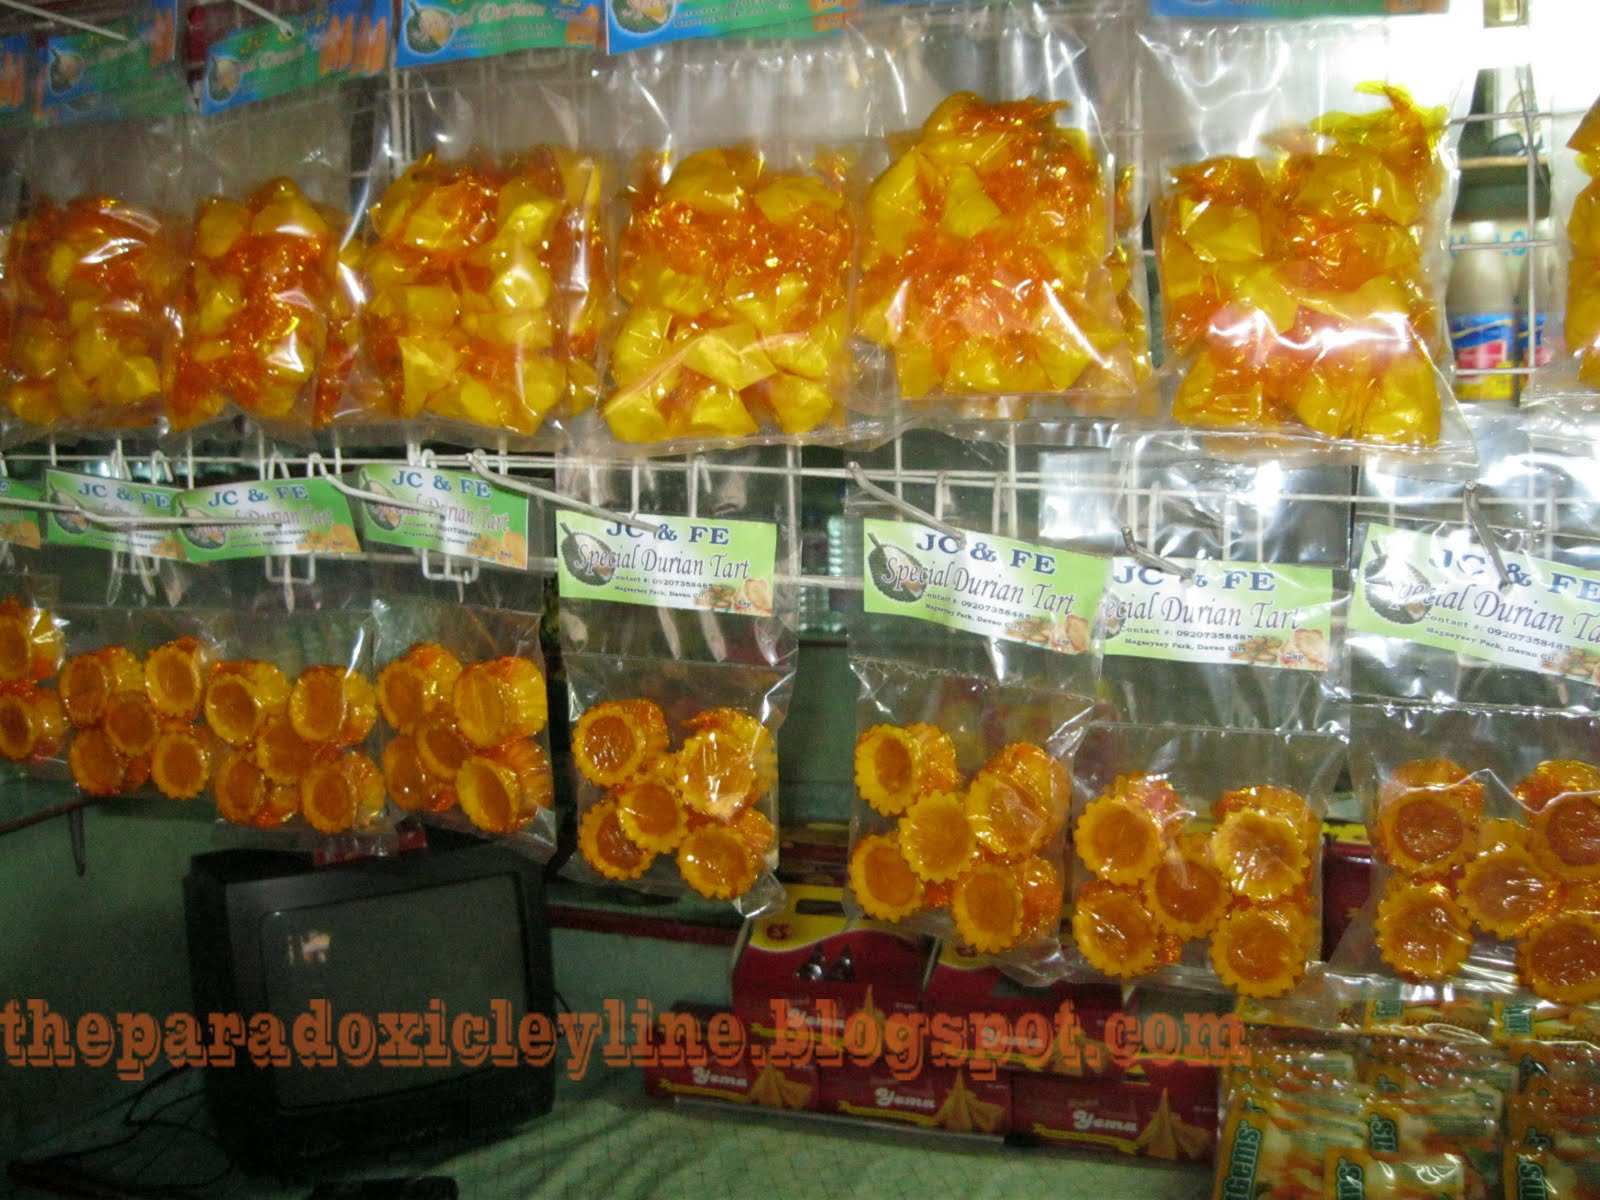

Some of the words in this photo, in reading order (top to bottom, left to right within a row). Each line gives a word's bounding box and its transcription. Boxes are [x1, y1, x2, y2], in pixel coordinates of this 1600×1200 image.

[78, 482, 107, 498] JC
[116, 487, 133, 502] &
[140, 490, 171, 508] FE
[208, 490, 239, 507] JC
[248, 488, 269, 503] &
[275, 484, 309, 500] FE
[392, 470, 423, 488] JC
[432, 475, 452, 491] &
[459, 477, 492, 499] FE
[656, 523, 678, 542] &
[688, 525, 731, 546] FE
[574, 543, 641, 575] Special
[641, 549, 705, 577] Durian
[709, 553, 750, 580] Tart
[916, 533, 962, 555] JC
[970, 541, 997, 563] &
[1010, 547, 1057, 576] FE
[611, 574, 641, 583] Contact
[882, 556, 955, 592] Special
[953, 566, 1025, 604] Durian
[1031, 583, 1075, 616] Tart
[1112, 565, 1164, 586] JC
[1222, 569, 1276, 592] FE
[1505, 562, 1532, 588] &
[1548, 571, 1600, 604] FE
[921, 590, 951, 603] Contact
[1105, 591, 1160, 622] ecial
[1161, 595, 1242, 628] Durian
[1250, 599, 1301, 631] Tart
[1422, 611, 1469, 629] Contact
[1474, 583, 1565, 635] Durian
[1573, 610, 1600, 645] Ta
[1120, 625, 1161, 636] Contact
[1507, 645, 1538, 658] Davao
